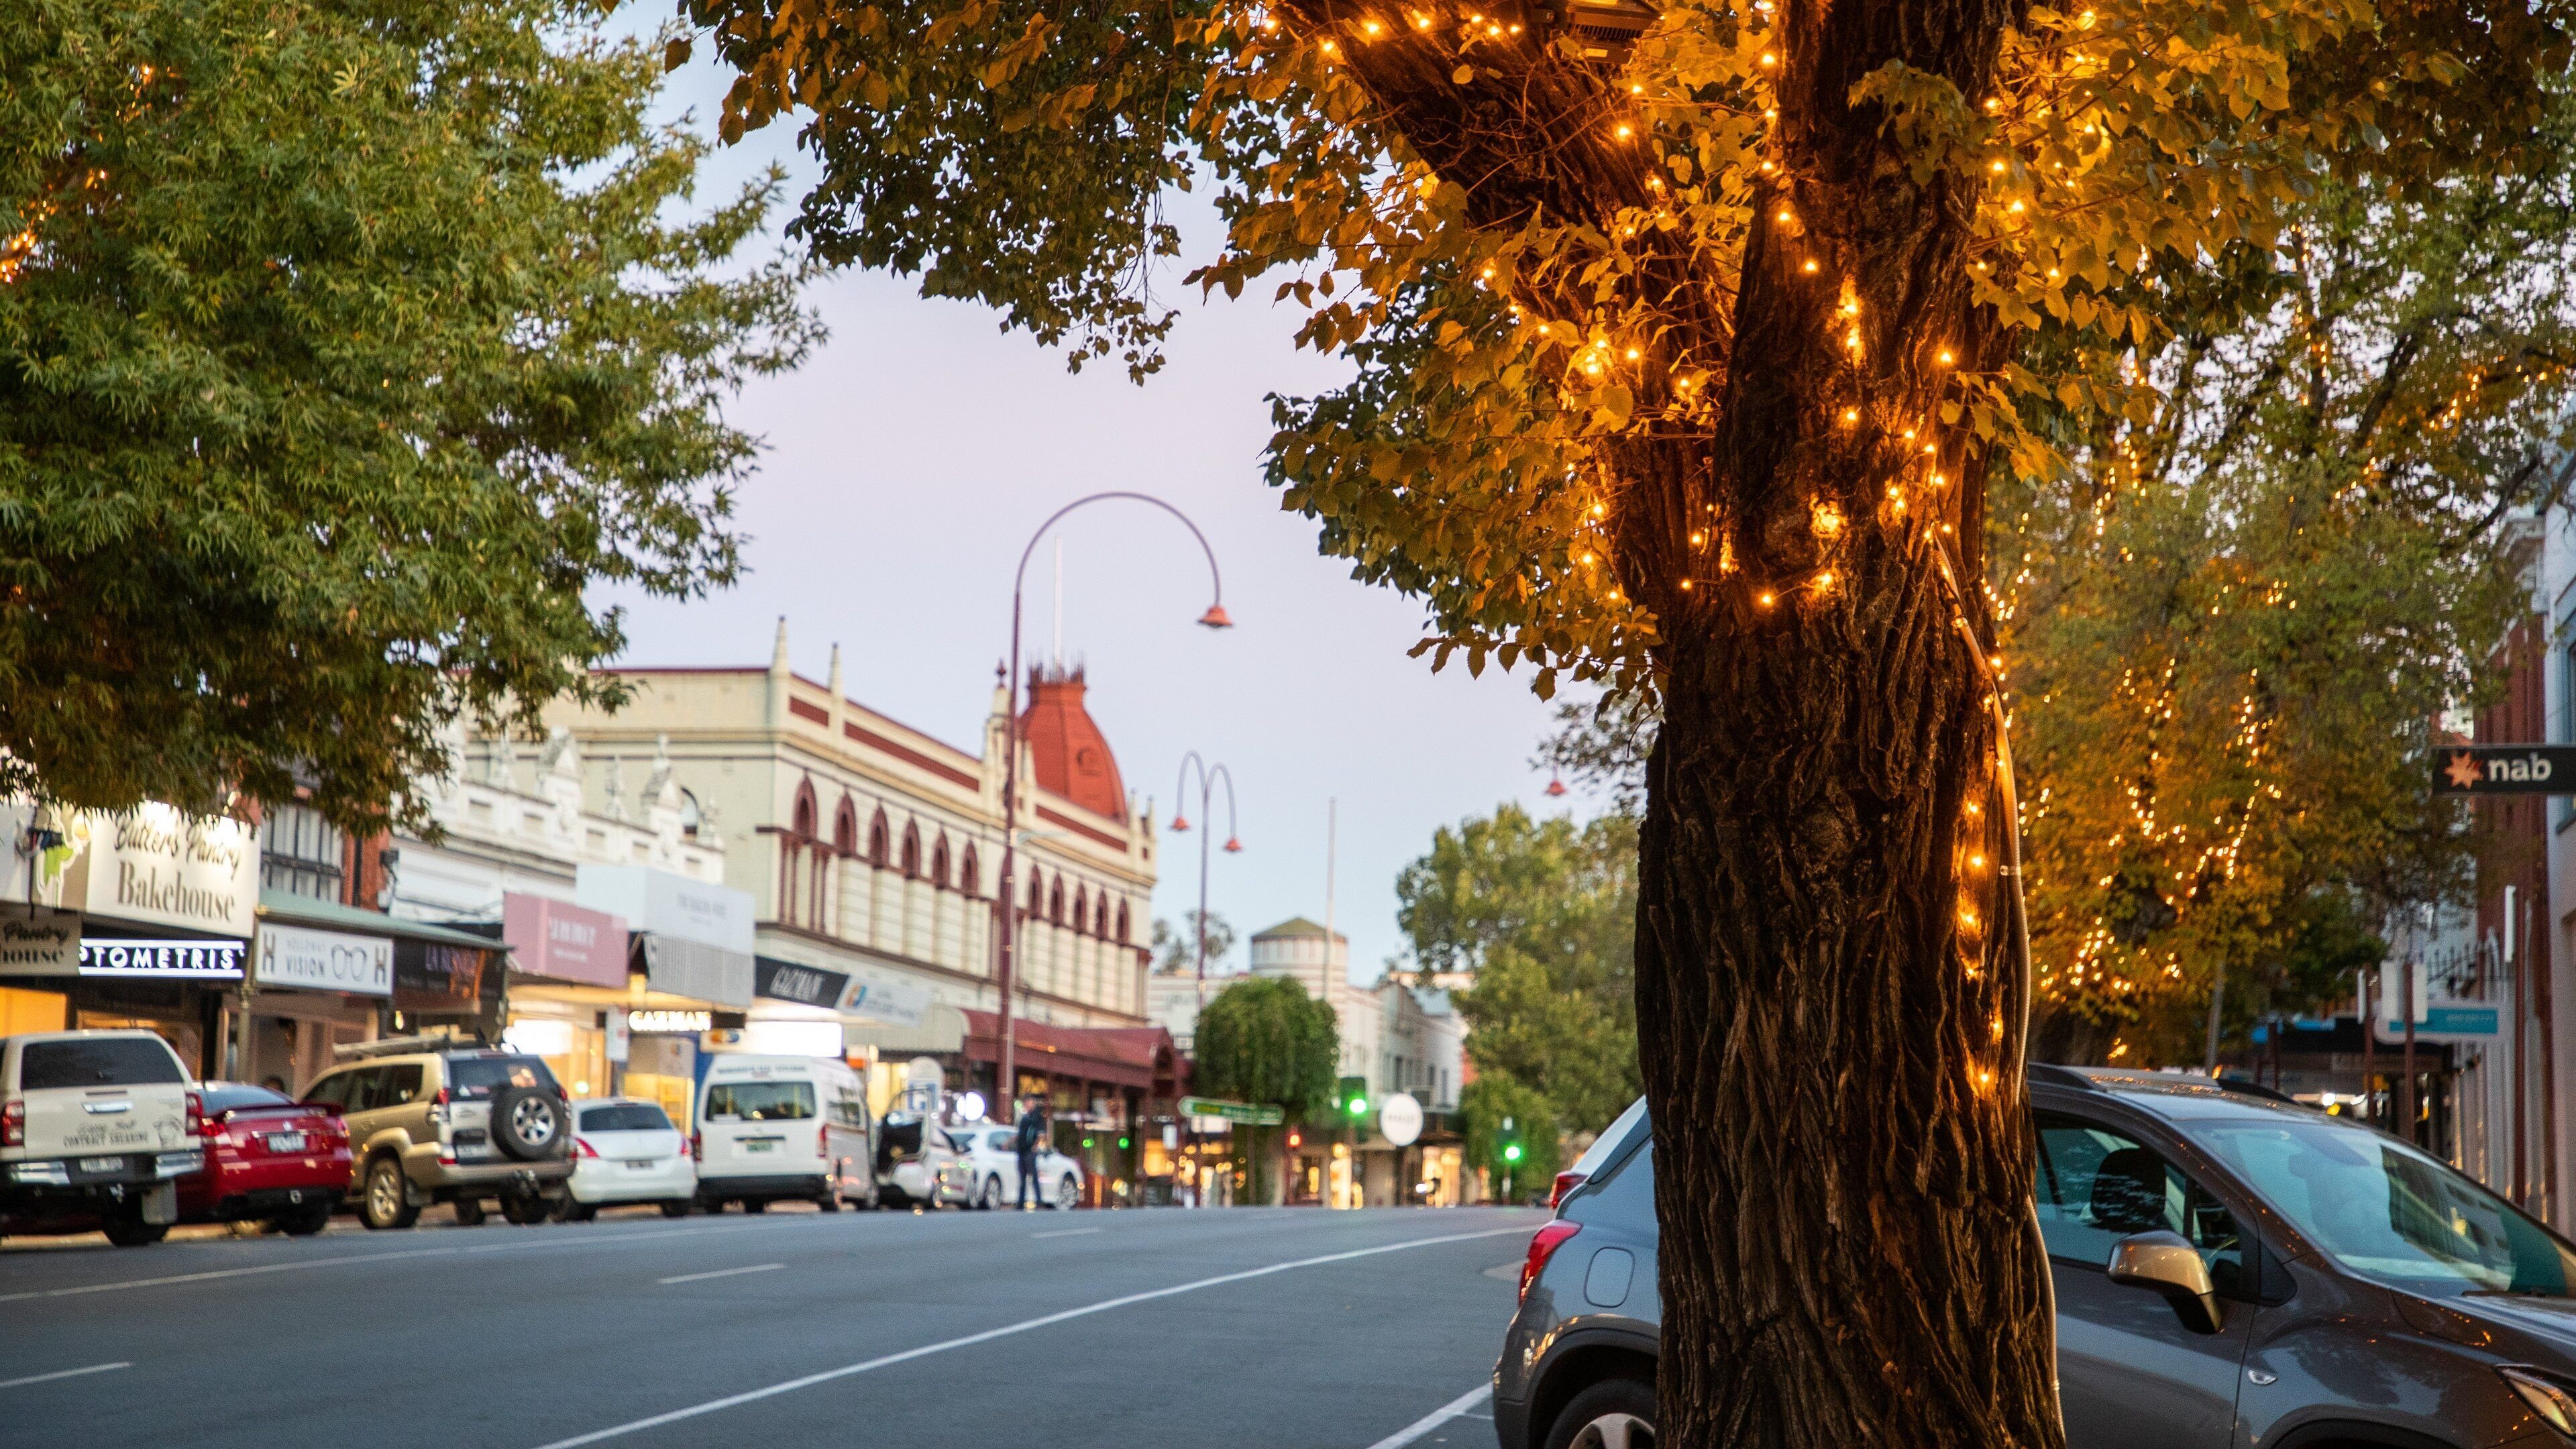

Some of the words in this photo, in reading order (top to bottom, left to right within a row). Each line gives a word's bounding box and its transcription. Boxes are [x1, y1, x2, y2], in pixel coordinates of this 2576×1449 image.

[2487, 751, 2552, 782] nab
[185, 824, 240, 881] Pantry
[117, 859, 235, 922] Bakehouse
[286, 955, 325, 977] VISION
[769, 965, 825, 1001] GAZMAN
